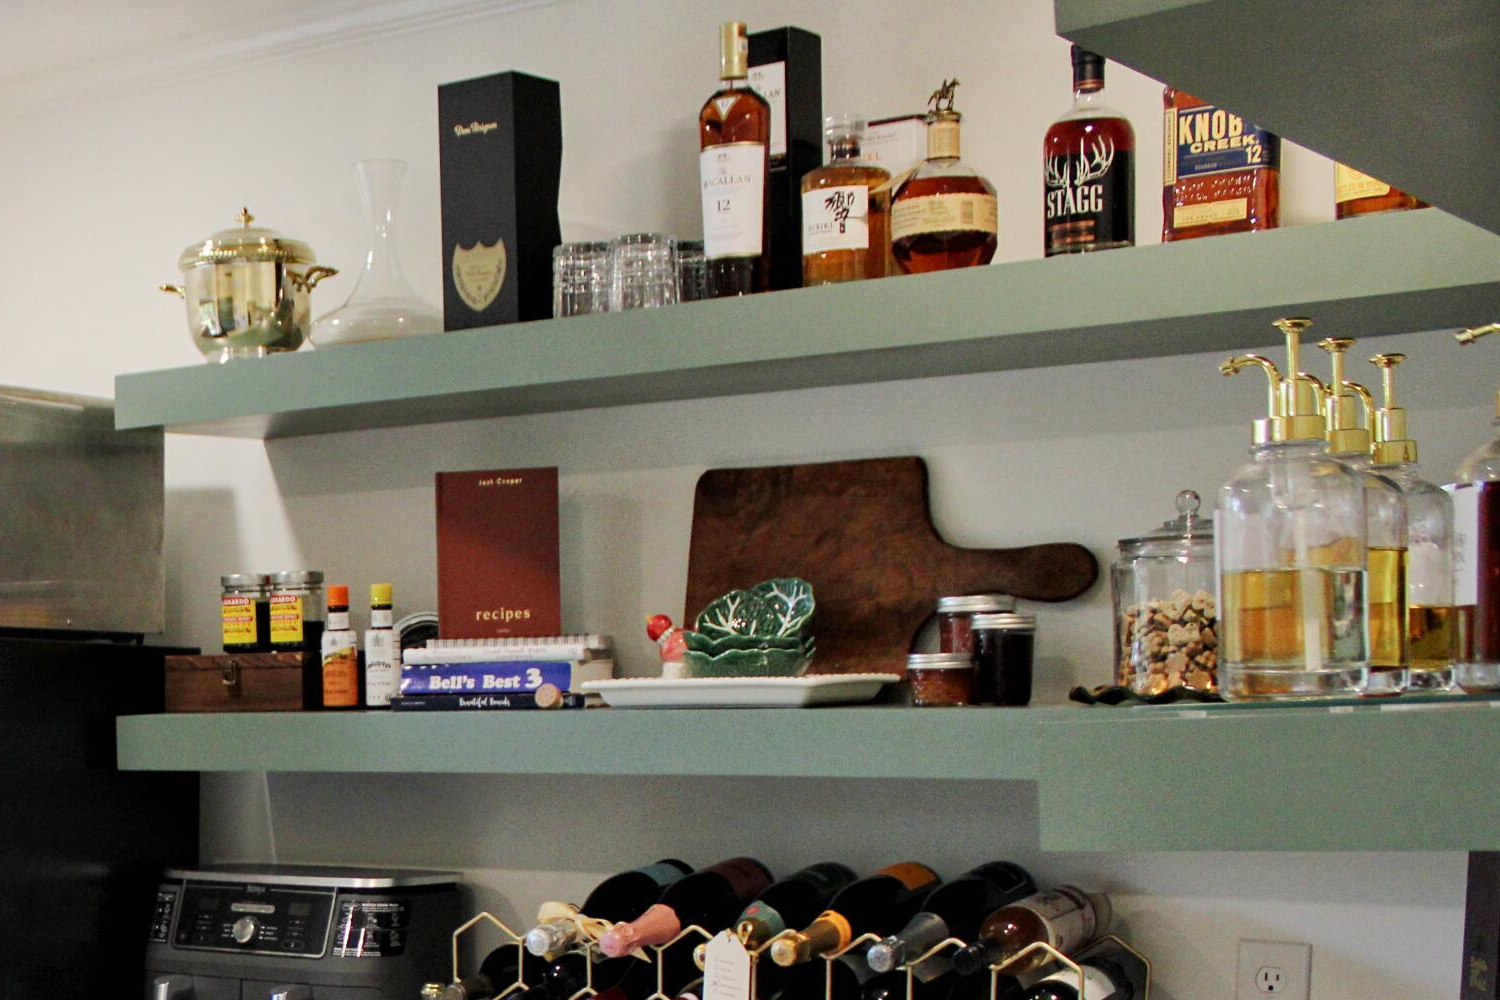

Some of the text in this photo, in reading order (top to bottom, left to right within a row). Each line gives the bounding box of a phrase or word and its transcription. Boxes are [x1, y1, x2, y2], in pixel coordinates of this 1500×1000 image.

[1179, 109, 1244, 145] KNOB
[1246, 146, 1262, 164] 12
[717, 199, 731, 212] 12
[1047, 184, 1103, 218] STAGG
[476, 607, 531, 623] recipes
[429, 667, 543, 690] Bell's Best 3
